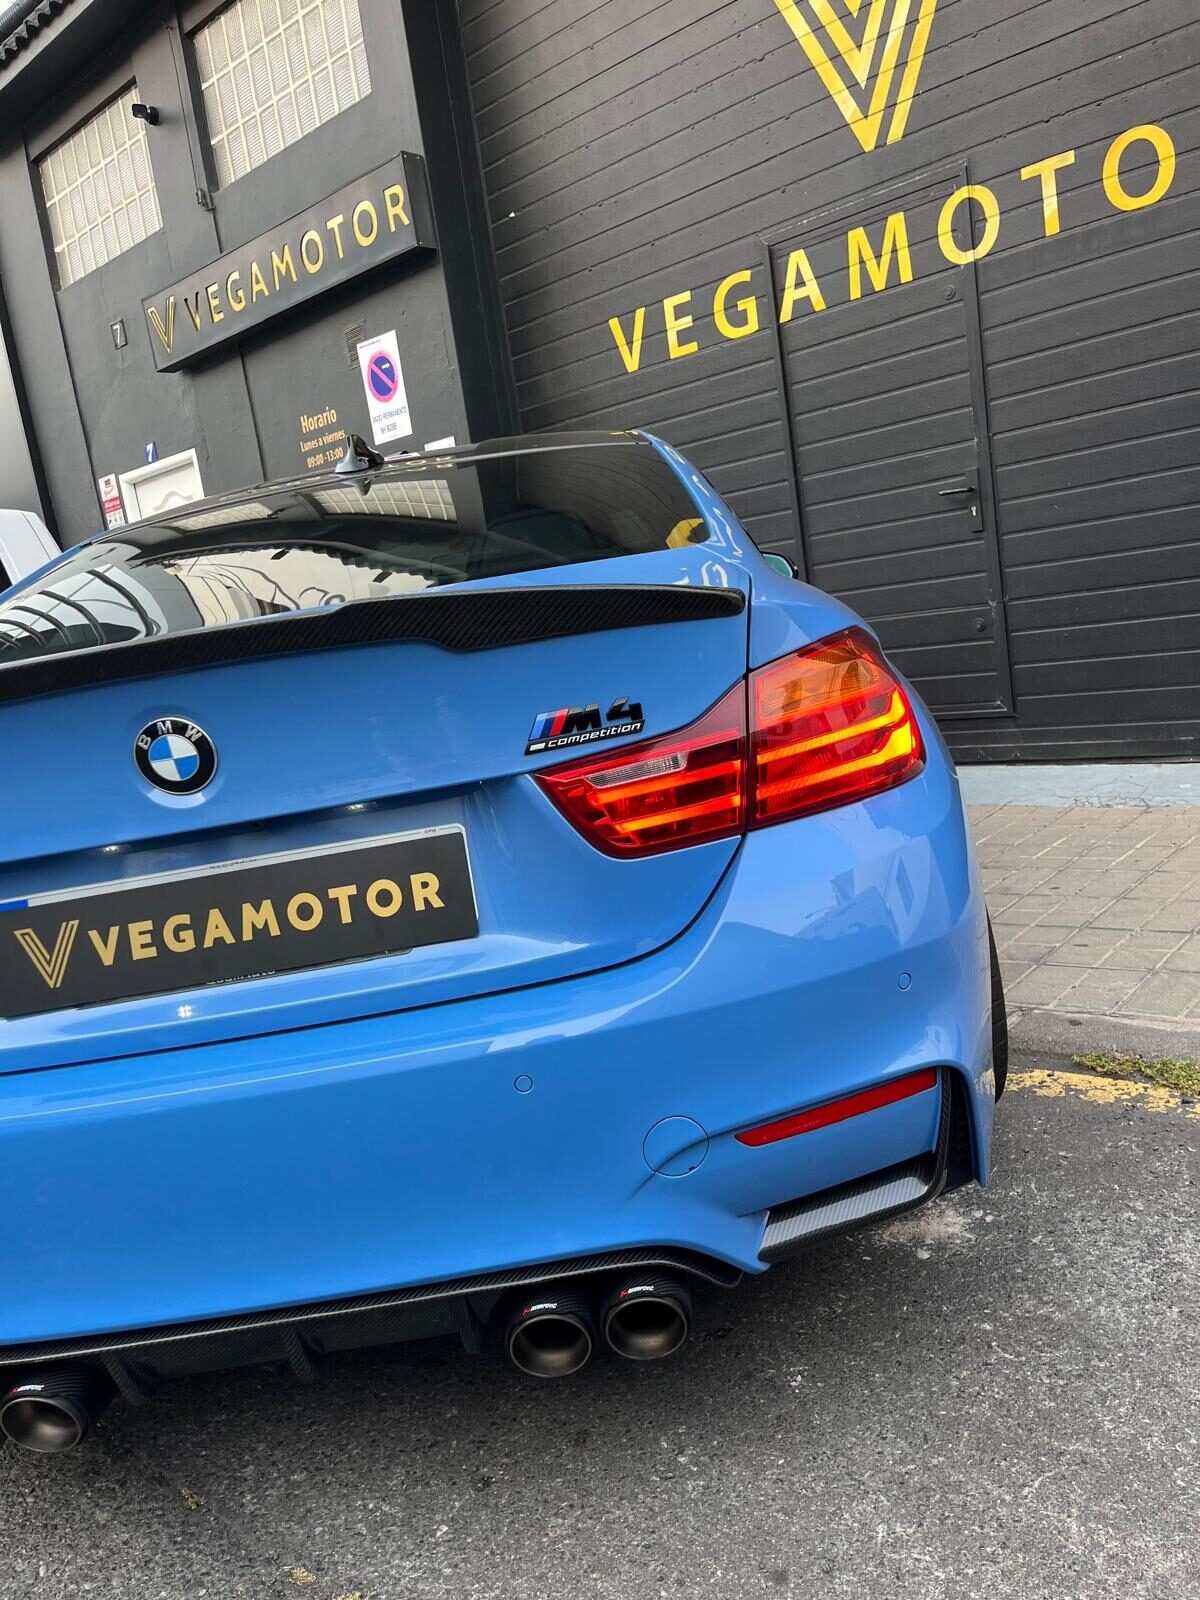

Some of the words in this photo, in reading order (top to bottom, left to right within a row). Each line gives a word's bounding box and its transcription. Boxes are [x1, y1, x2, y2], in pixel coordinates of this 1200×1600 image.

[183, 184, 411, 331] VEGAMOTOR
[608, 124, 1177, 374] VEGAMOTO
[112, 323, 122, 346] 7
[300, 406, 337, 433] Horario
[146, 443, 154, 462] 7
[300, 439, 318, 453] Lunes
[323, 429, 346, 444] viernes
[307, 453, 324, 468] 09:00
[326, 447, 344, 462] 13:00
[137, 721, 203, 751] BMW
[547, 722, 642, 748] competition
[88, 872, 446, 967] VEGAMOTOR
